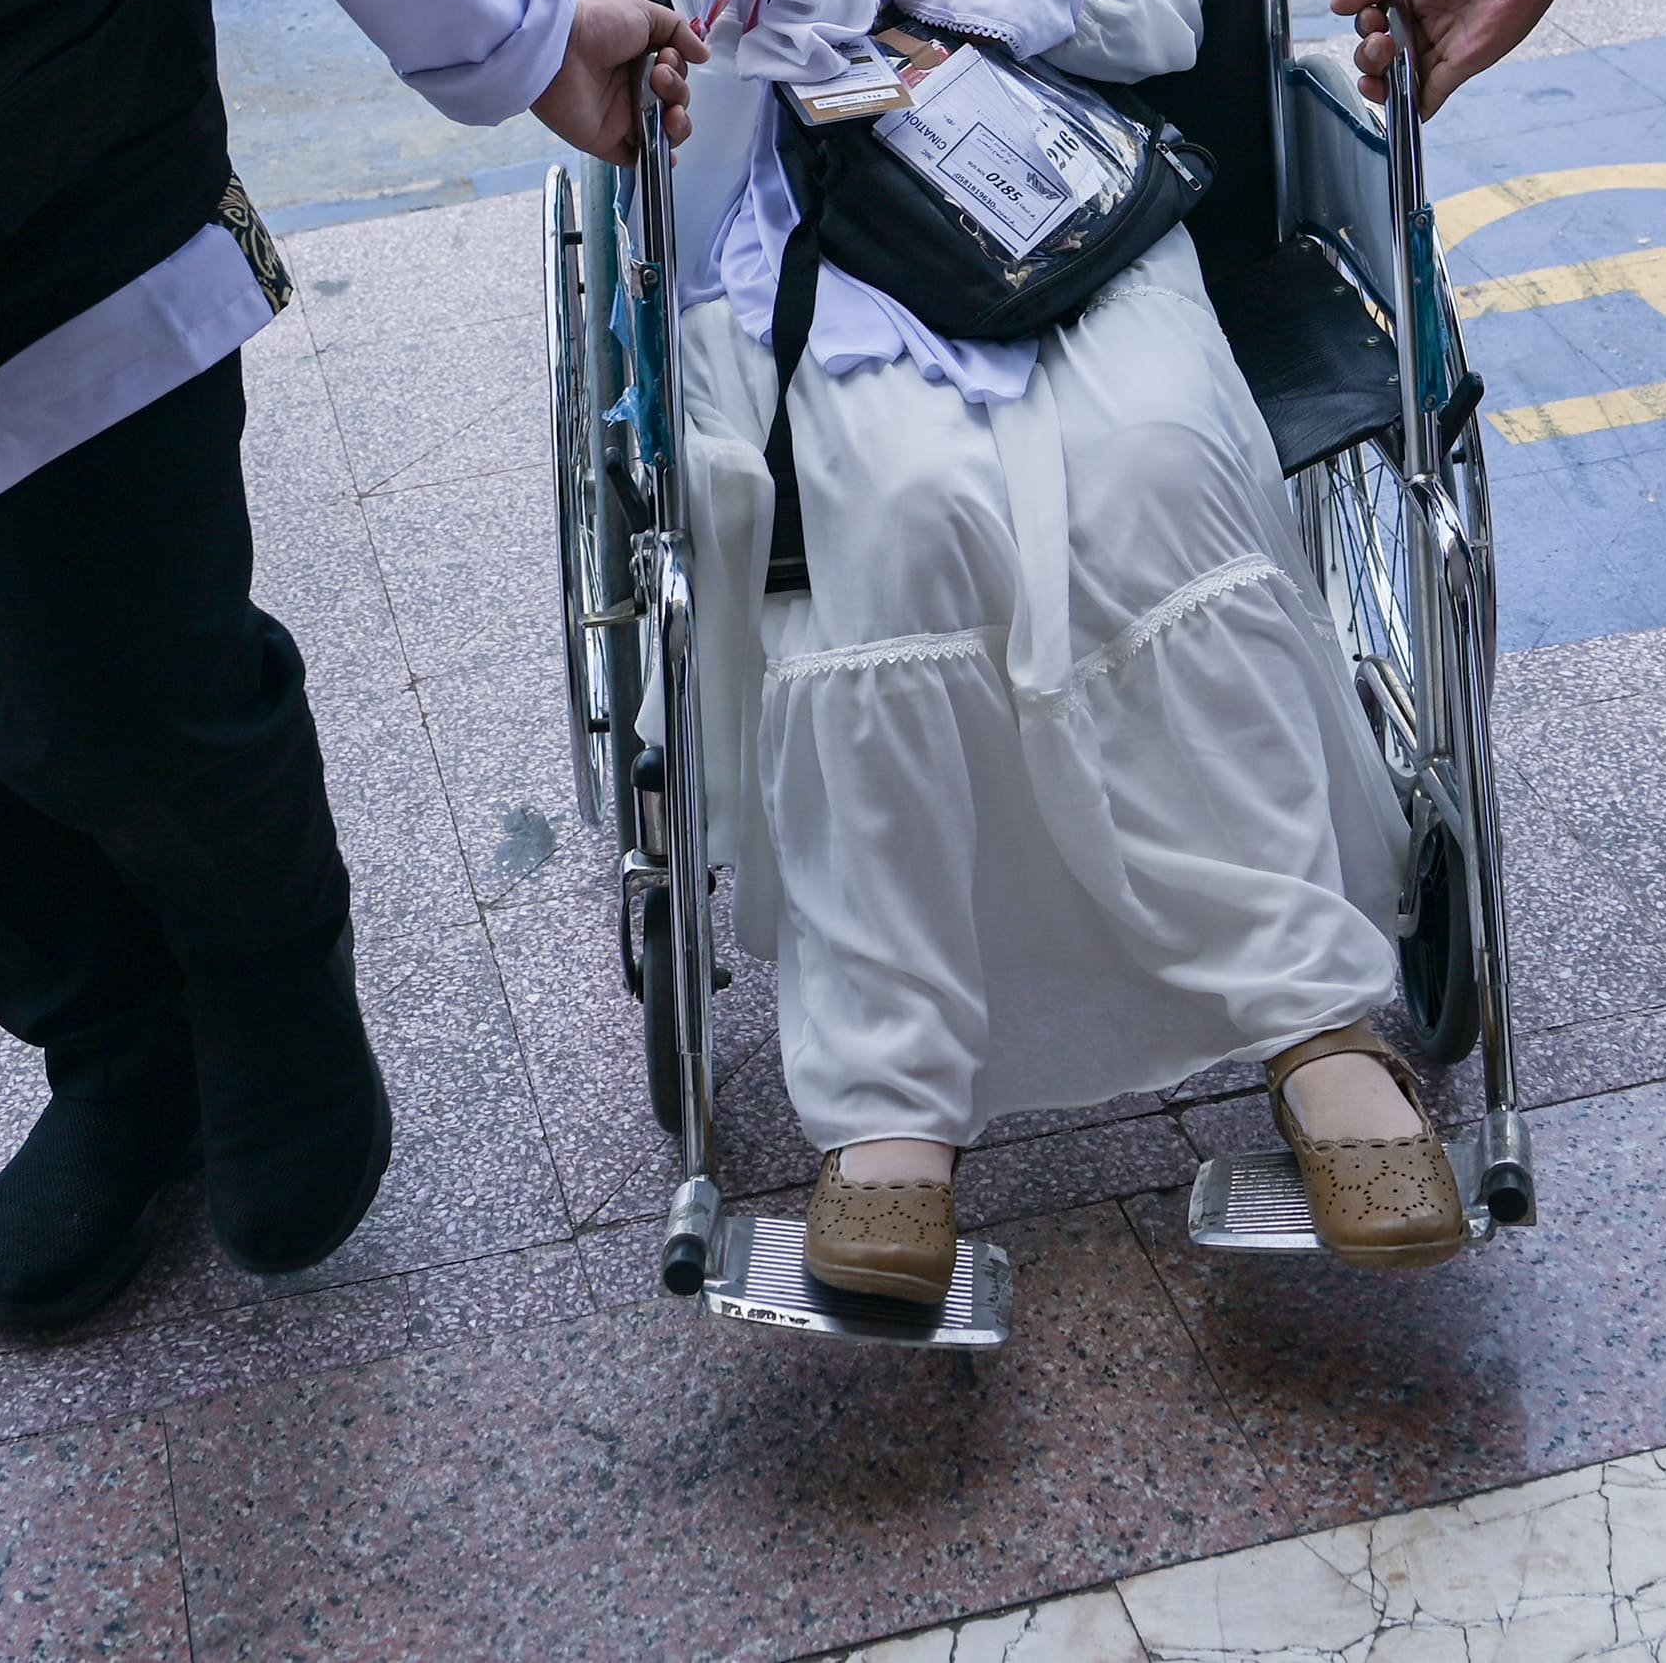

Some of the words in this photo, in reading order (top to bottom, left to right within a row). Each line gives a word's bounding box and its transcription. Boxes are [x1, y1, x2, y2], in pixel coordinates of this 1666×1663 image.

[901, 109, 948, 152] CINATION
[1044, 129, 1081, 171] 216
[985, 169, 1023, 202] 0185
